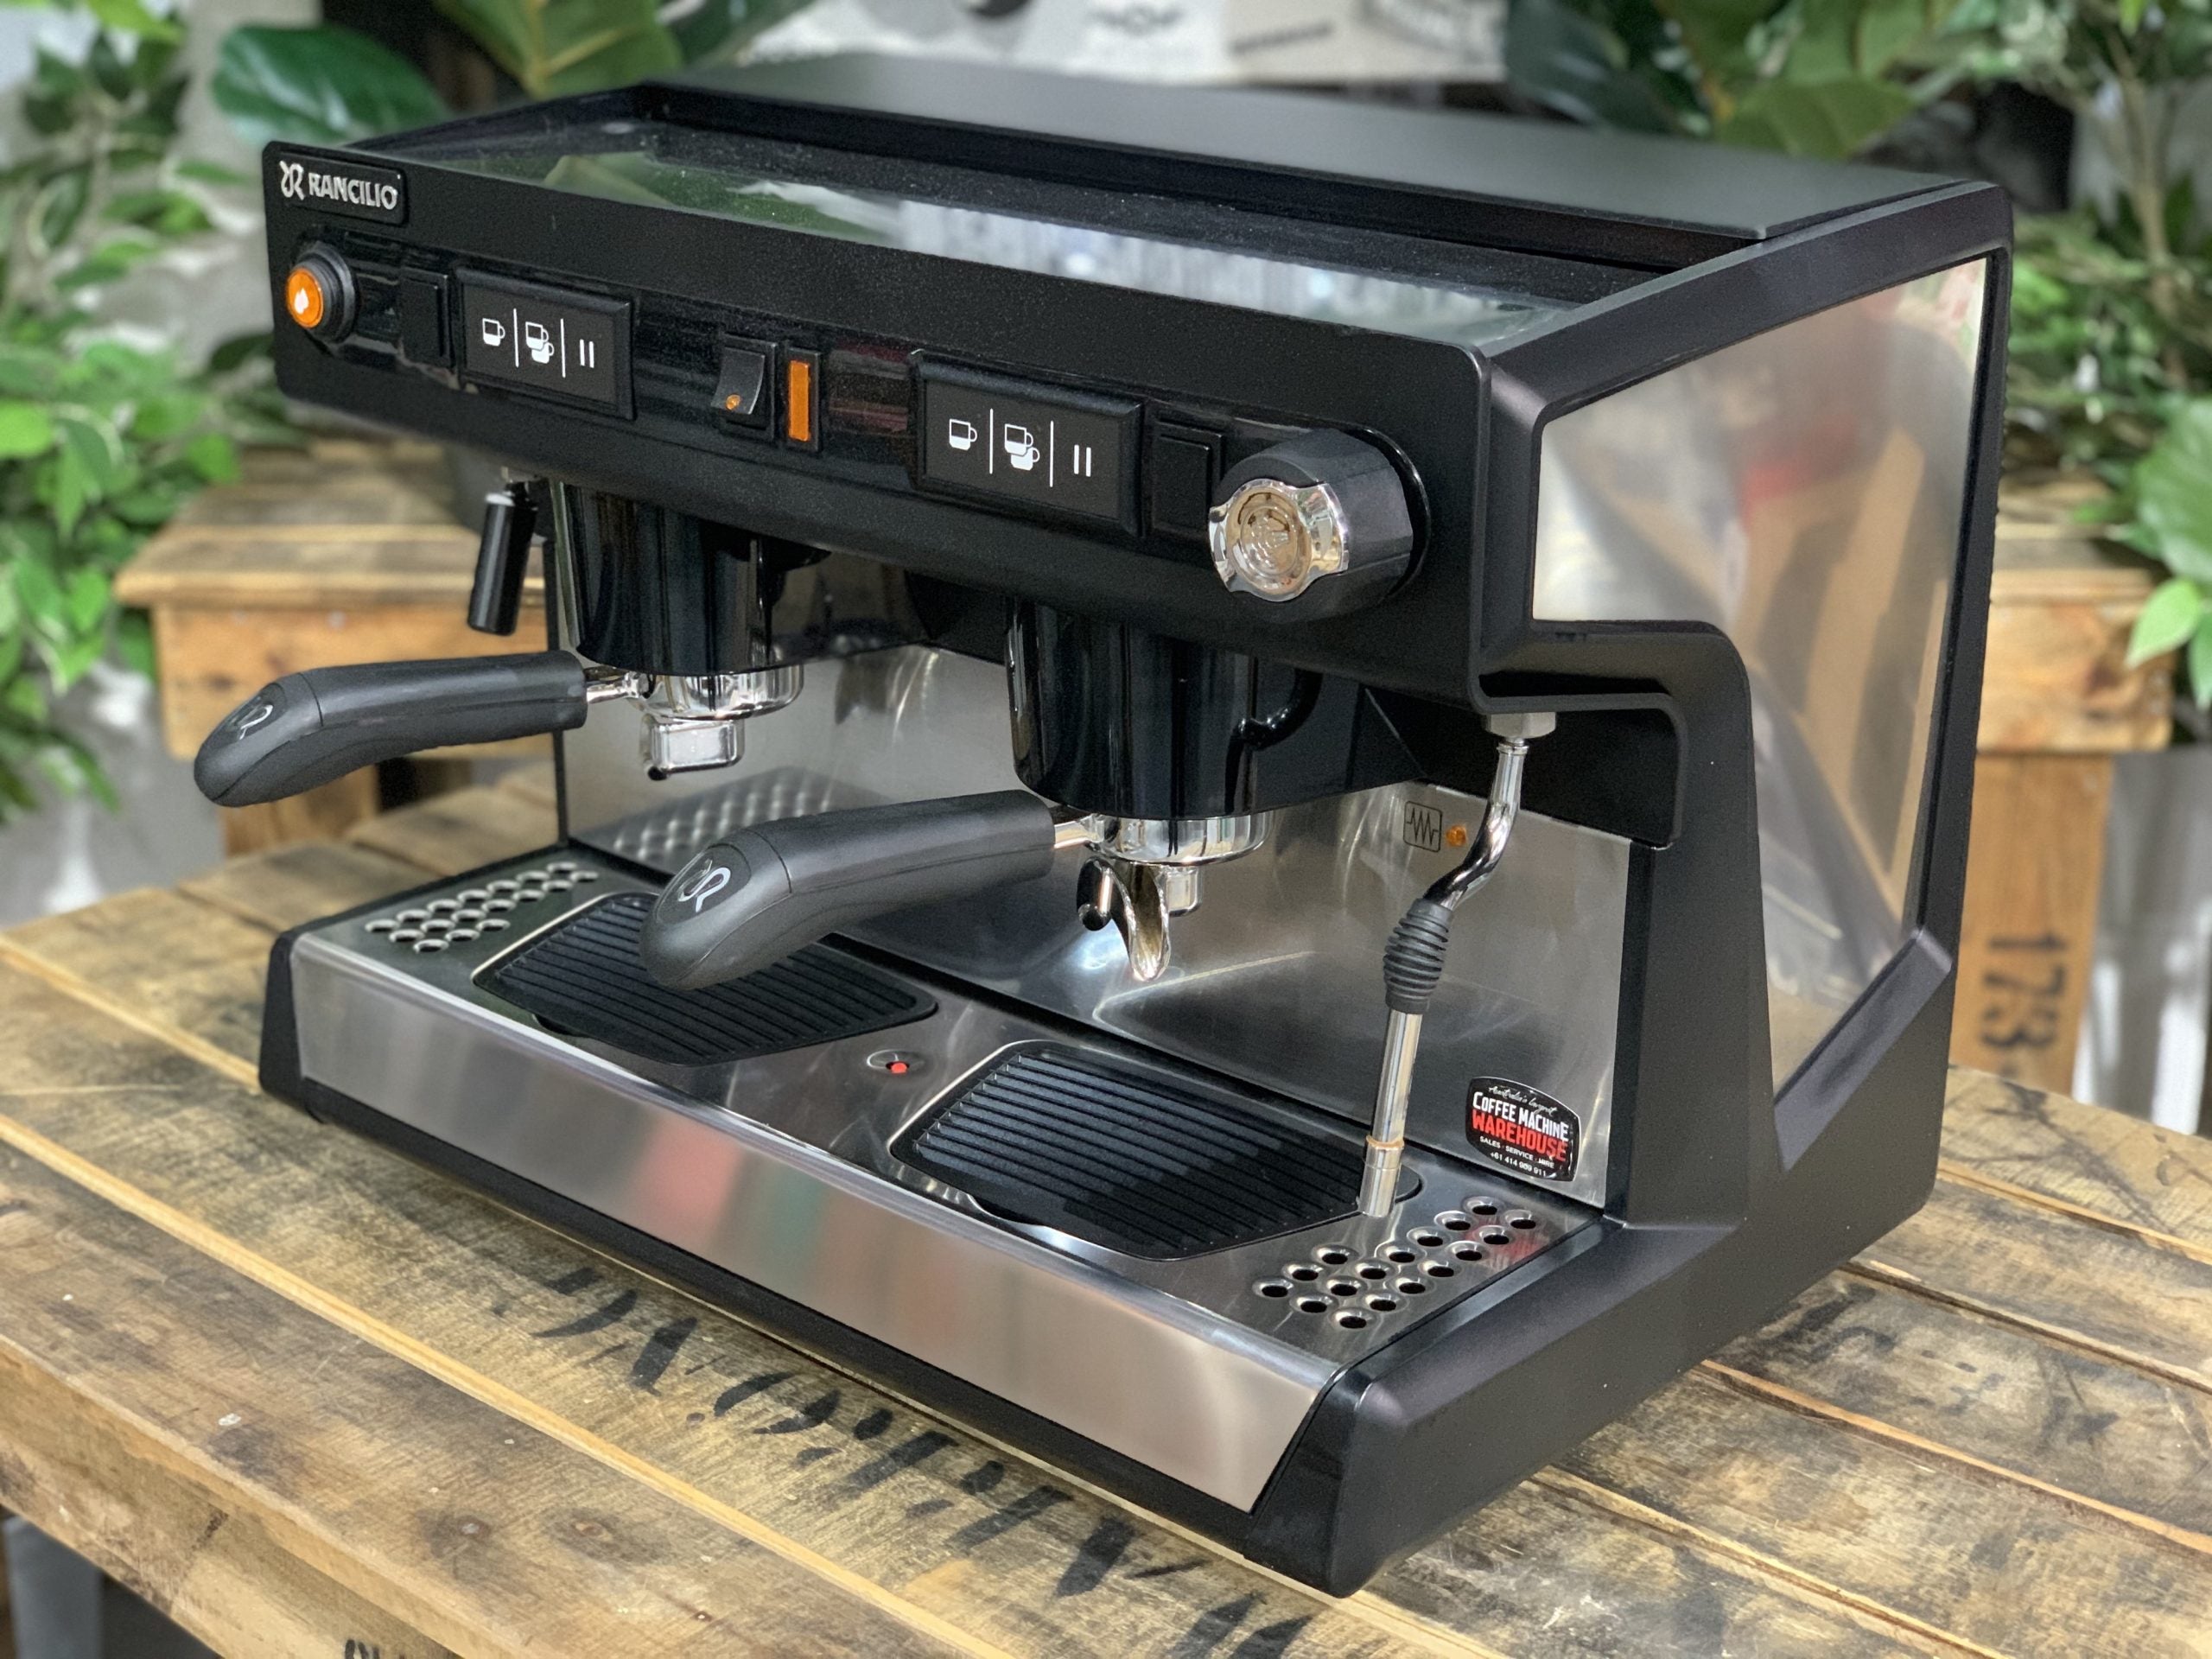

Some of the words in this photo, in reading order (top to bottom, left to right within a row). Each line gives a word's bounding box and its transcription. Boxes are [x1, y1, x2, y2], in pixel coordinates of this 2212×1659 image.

[308, 172, 398, 210] RANCILIO
[1472, 1091, 1516, 1122] COFFEE
[1518, 1107, 1569, 1141] MACHINE
[1472, 1109, 1568, 1162] WAREHOUSE
[1479, 1135, 1501, 1148] SALES
[1505, 1145, 1534, 1160] SERVICE
[1504, 1156, 1518, 1166] 414
